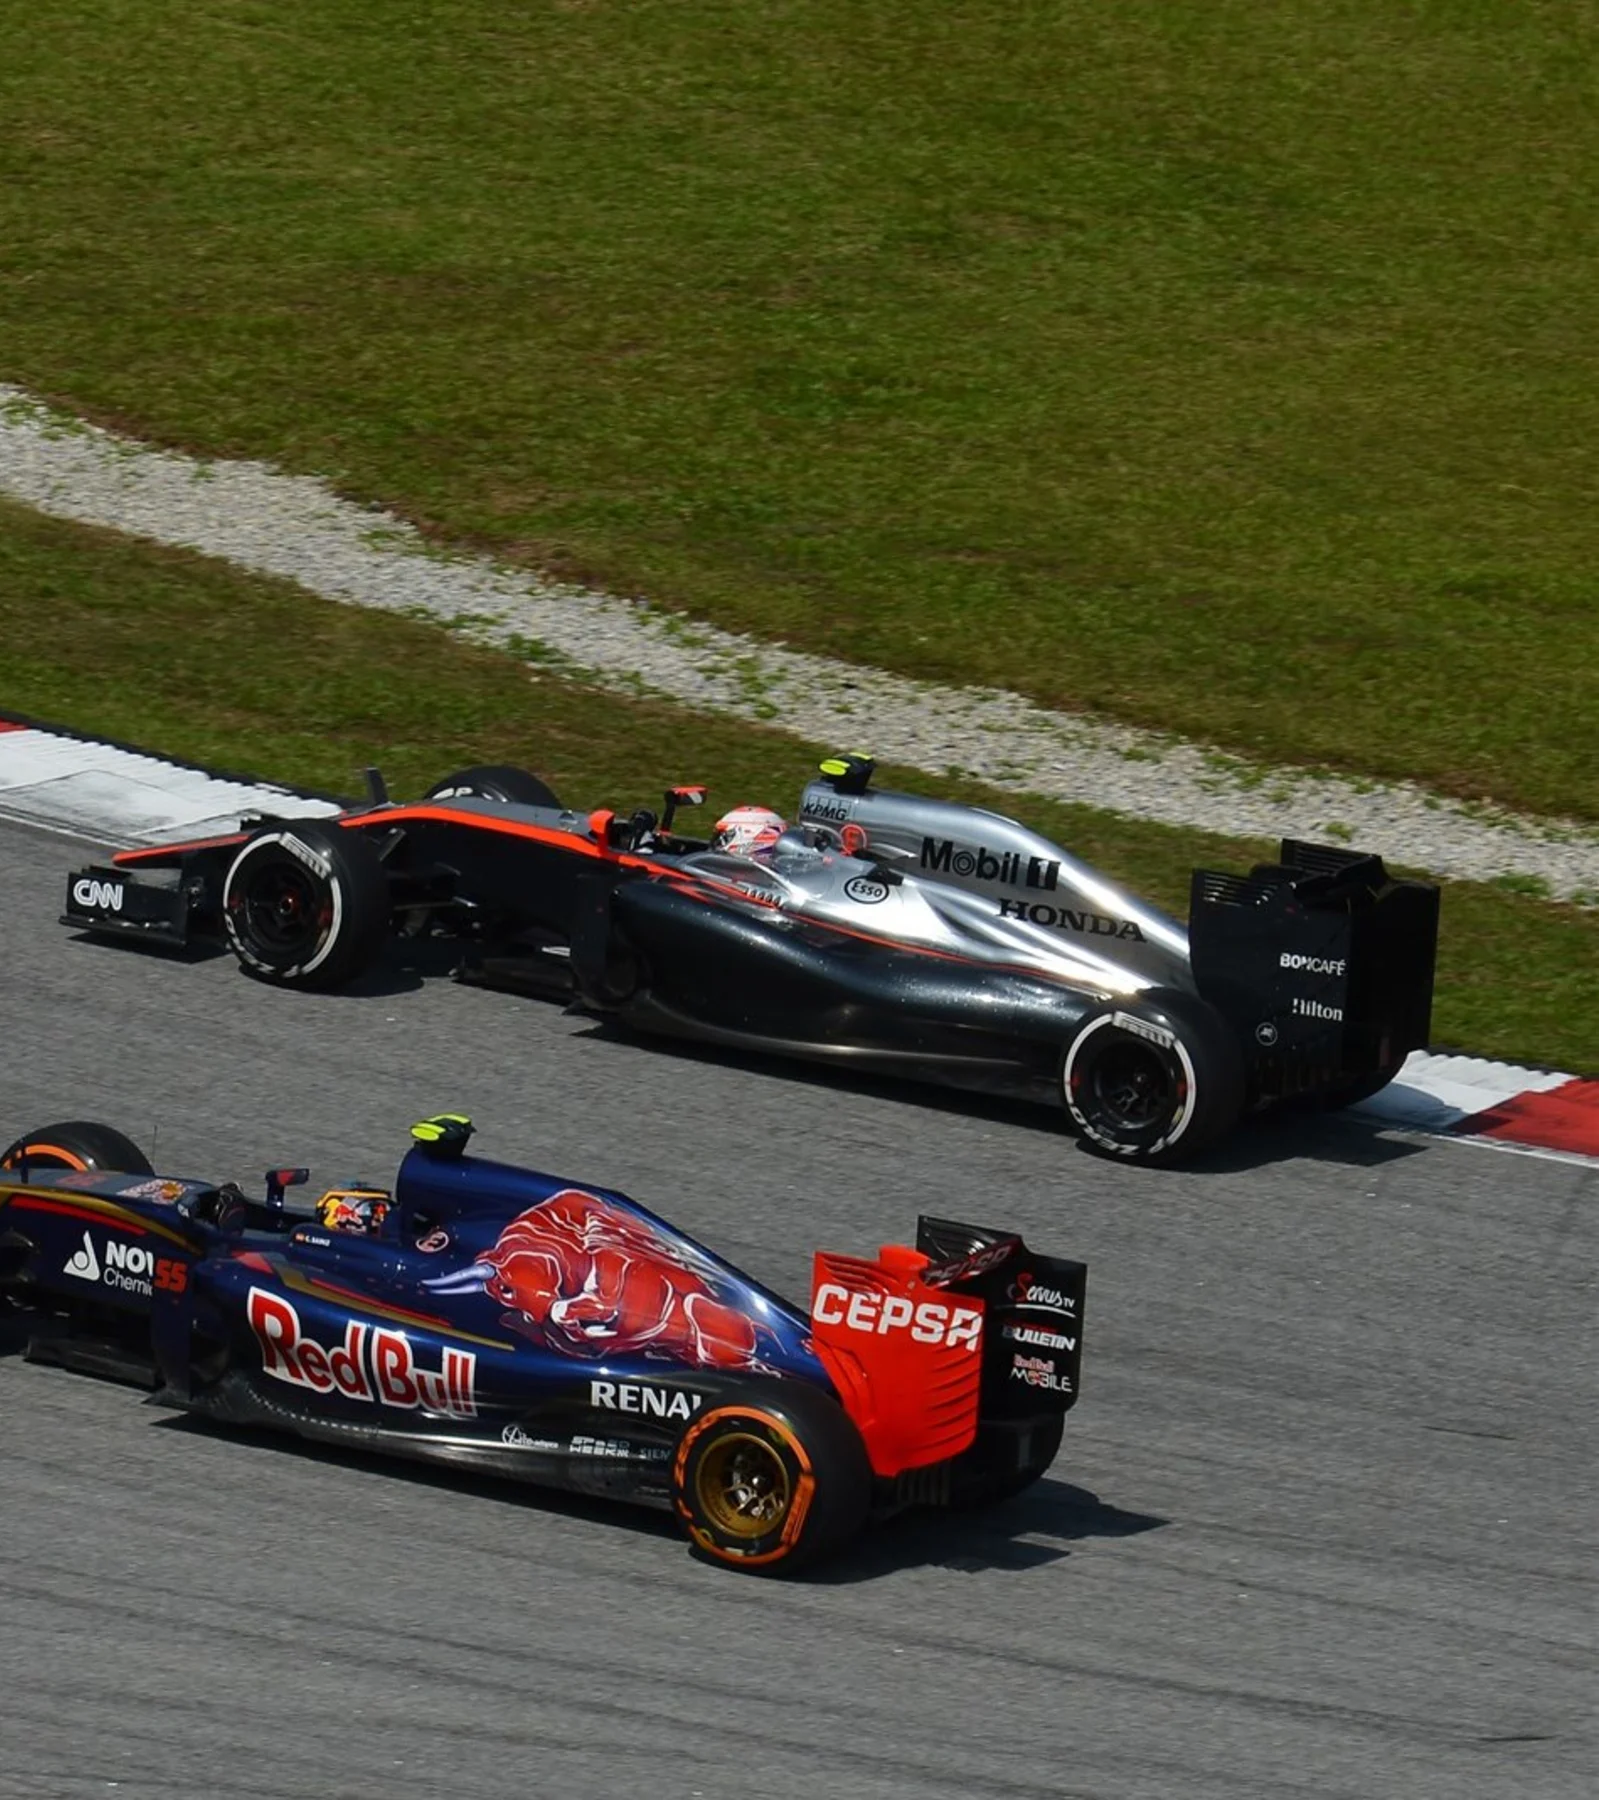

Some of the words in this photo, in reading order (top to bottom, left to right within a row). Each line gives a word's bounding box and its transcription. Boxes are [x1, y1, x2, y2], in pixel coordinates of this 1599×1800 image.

[803, 801, 848, 821] KPMG
[920, 836, 1020, 885] Mobil
[73, 879, 124, 911] CNN
[997, 898, 1148, 943] HONDA
[1280, 952, 1346, 976] BONCAFÉ
[1292, 998, 1344, 1022] Hilton
[813, 1283, 984, 1352] CEPSA
[247, 1286, 374, 1402] Red
[371, 1326, 478, 1418] Bull
